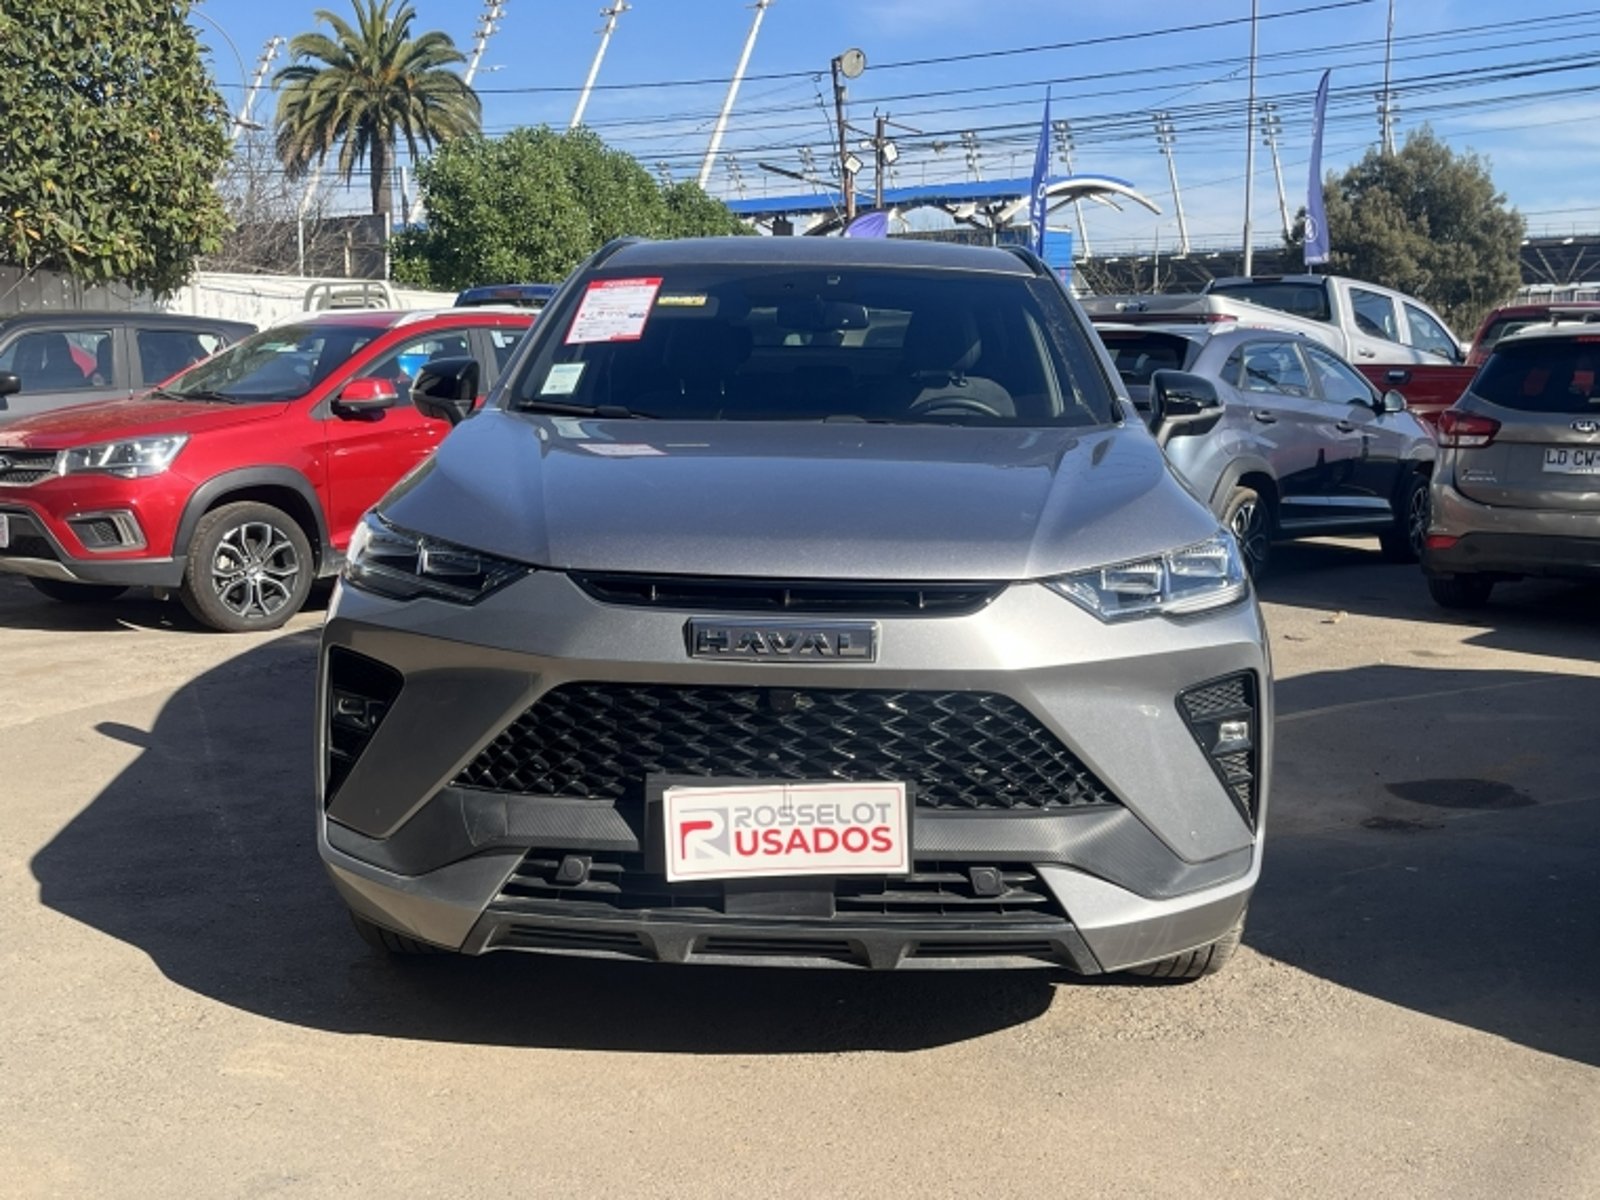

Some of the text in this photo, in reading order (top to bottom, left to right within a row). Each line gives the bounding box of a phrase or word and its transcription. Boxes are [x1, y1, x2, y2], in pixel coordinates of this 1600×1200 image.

[697, 630, 867, 656] HAVAL
[734, 802, 892, 828] ROSSELOT
[735, 826, 893, 856] USADOS
